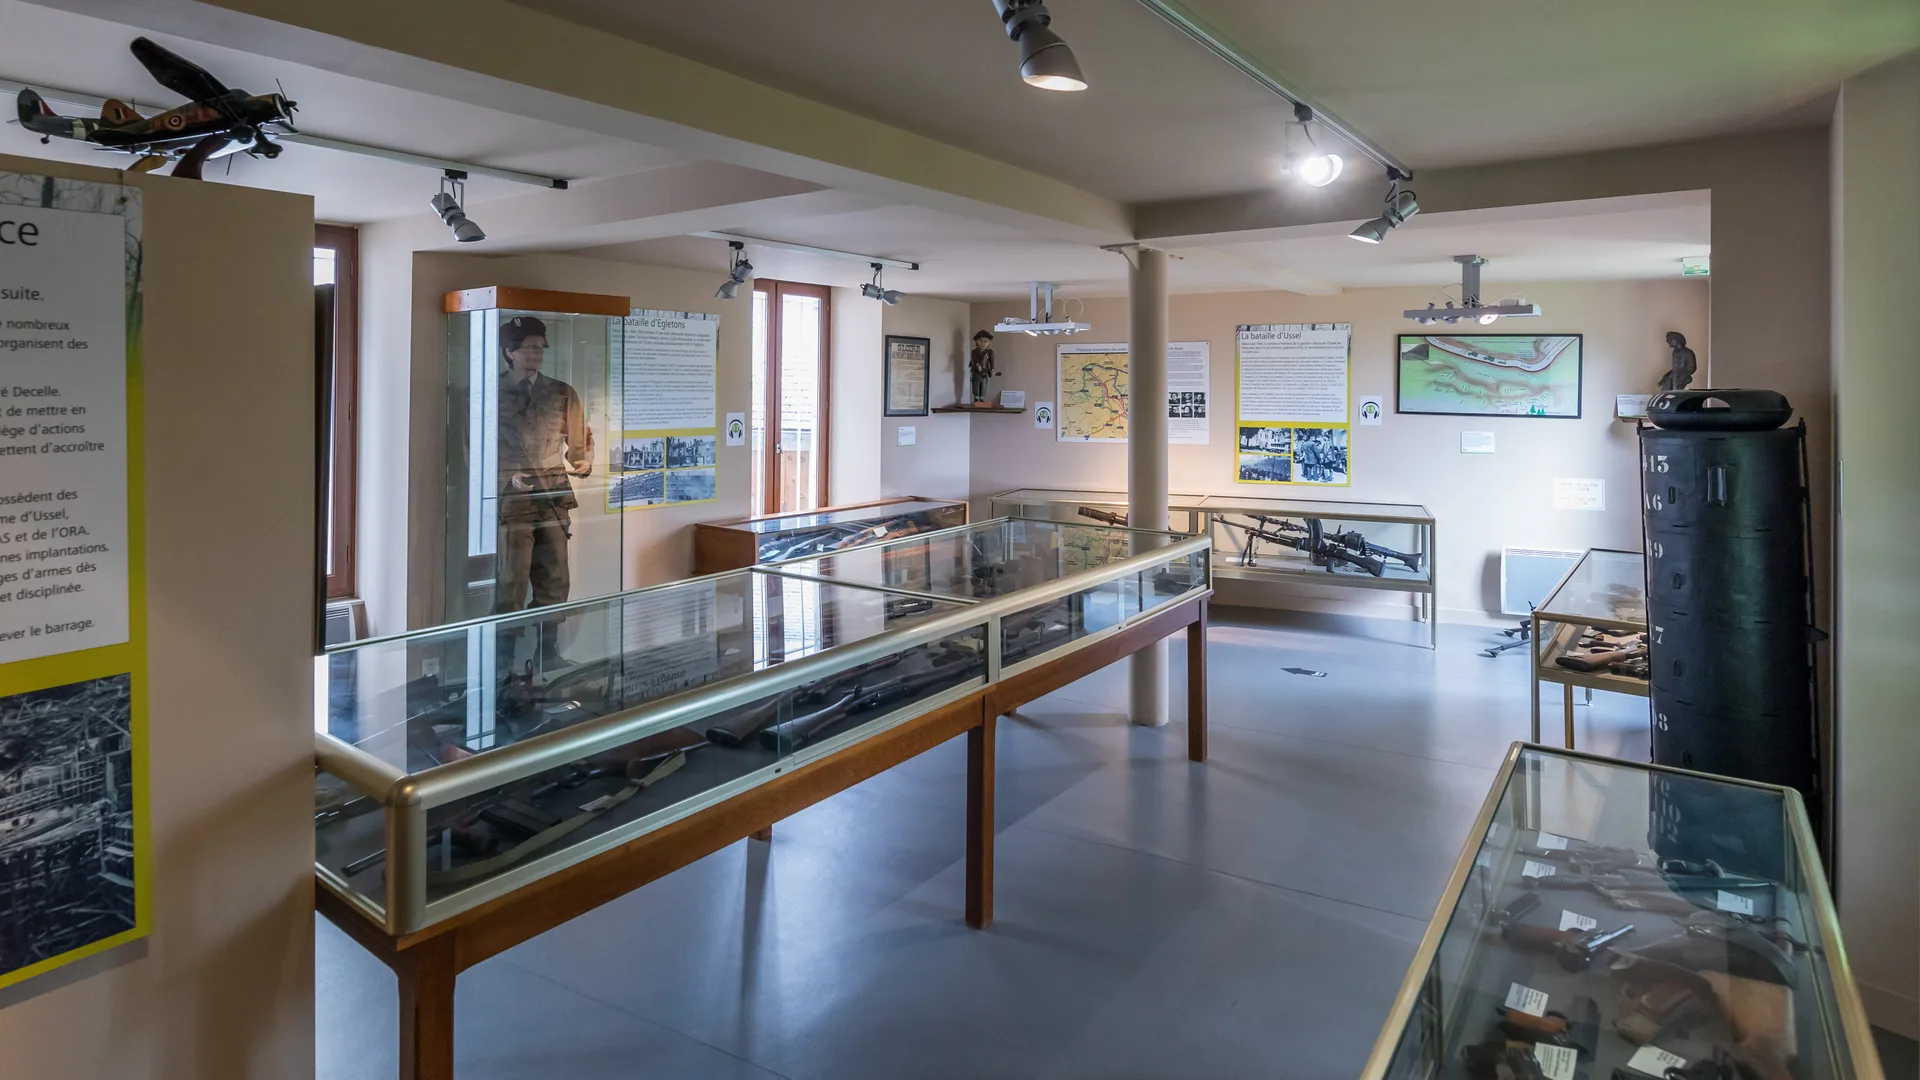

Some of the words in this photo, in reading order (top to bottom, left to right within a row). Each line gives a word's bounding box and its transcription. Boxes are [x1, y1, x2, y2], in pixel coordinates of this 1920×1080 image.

[1, 286, 44, 301] suite.
[7, 318, 70, 331] nombreux
[1241, 332, 1249, 340] La
[1251, 332, 1275, 340] bataille
[1277, 331, 1302, 340] d'Ussel
[67, 338, 88, 349] des
[13, 386, 61, 397] Decelle.
[6, 406, 22, 416] de
[26, 406, 67, 416] mettre
[71, 406, 86, 415] en
[29, 423, 85, 436] d'actions
[41, 441, 105, 455] d'accroître
[57, 488, 78, 500] des
[20, 508, 69, 523] d'Ussel,
[15, 532, 28, 542] et
[32, 528, 47, 540] de
[51, 525, 90, 539] l'ORA.
[25, 542, 109, 561] implantations.
[22, 565, 72, 580] d'armes
[76, 561, 97, 574] dès
[16, 583, 84, 599] disciplinée.
[30, 625, 41, 636] le
[45, 617, 95, 635] barrage.
